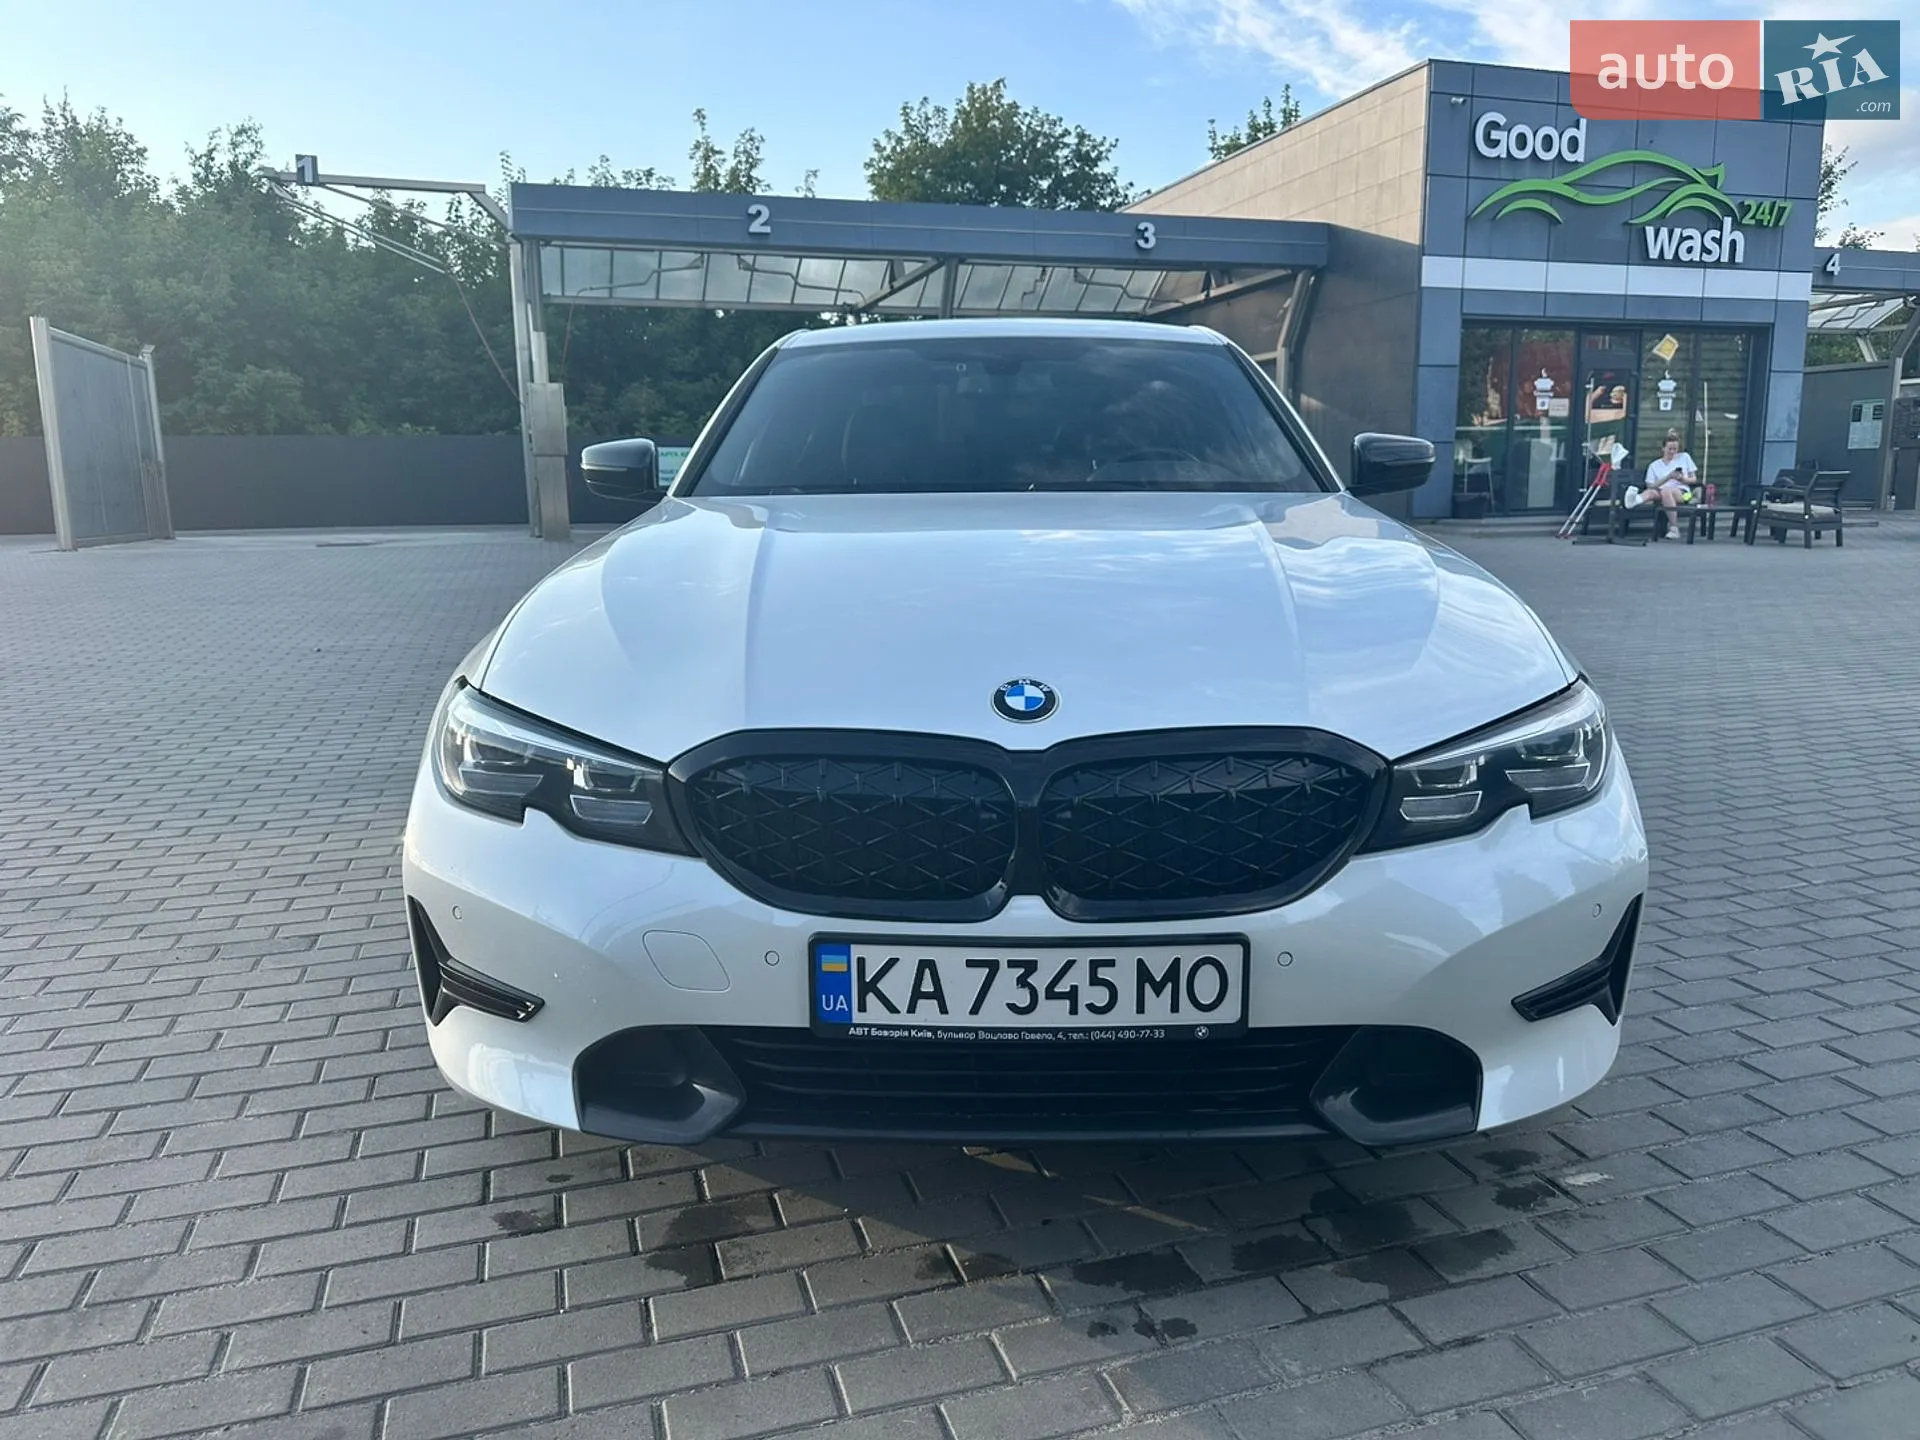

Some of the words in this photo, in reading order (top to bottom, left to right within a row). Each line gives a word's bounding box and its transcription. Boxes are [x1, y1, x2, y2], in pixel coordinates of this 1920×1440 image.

[1474, 111, 1587, 163] Good
[297, 156, 313, 183] 1
[747, 203, 771, 233] 2
[1741, 199, 1793, 228] 24/7
[1136, 221, 1156, 249] 3
[1644, 216, 1745, 264] wash
[1825, 253, 1841, 276] 4
[856, 956, 950, 1015] KA
[965, 957, 1119, 1016] 7345
[821, 994, 849, 1012] UA
[937, 1029, 976, 1040] бульвар
[1090, 1030, 1115, 1041] (044)
[1117, 1029, 1165, 1039] 490-77-33
